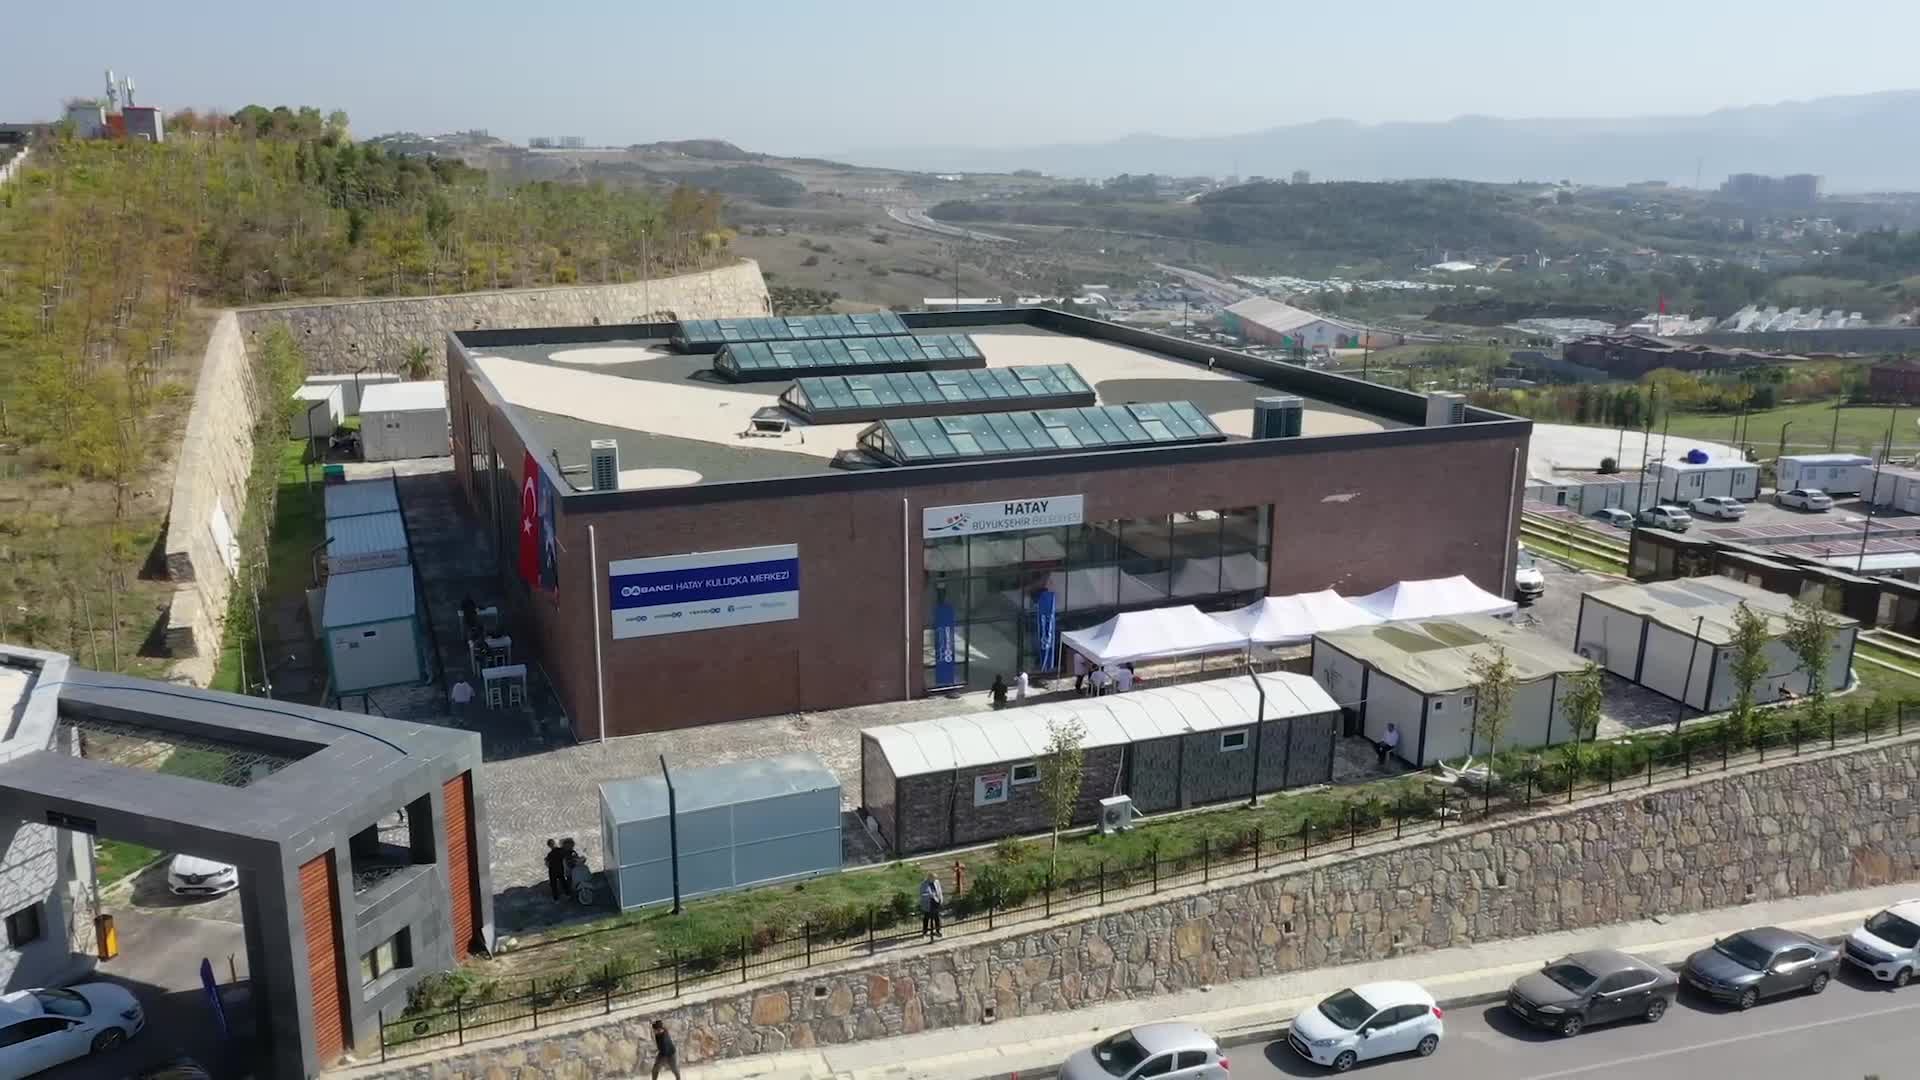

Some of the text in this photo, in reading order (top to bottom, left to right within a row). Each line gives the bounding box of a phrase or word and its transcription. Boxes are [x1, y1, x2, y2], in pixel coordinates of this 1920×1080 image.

[1004, 500, 1049, 515] HATAY
[621, 584, 673, 597] SABANCI
[676, 580, 703, 591] HATAY
